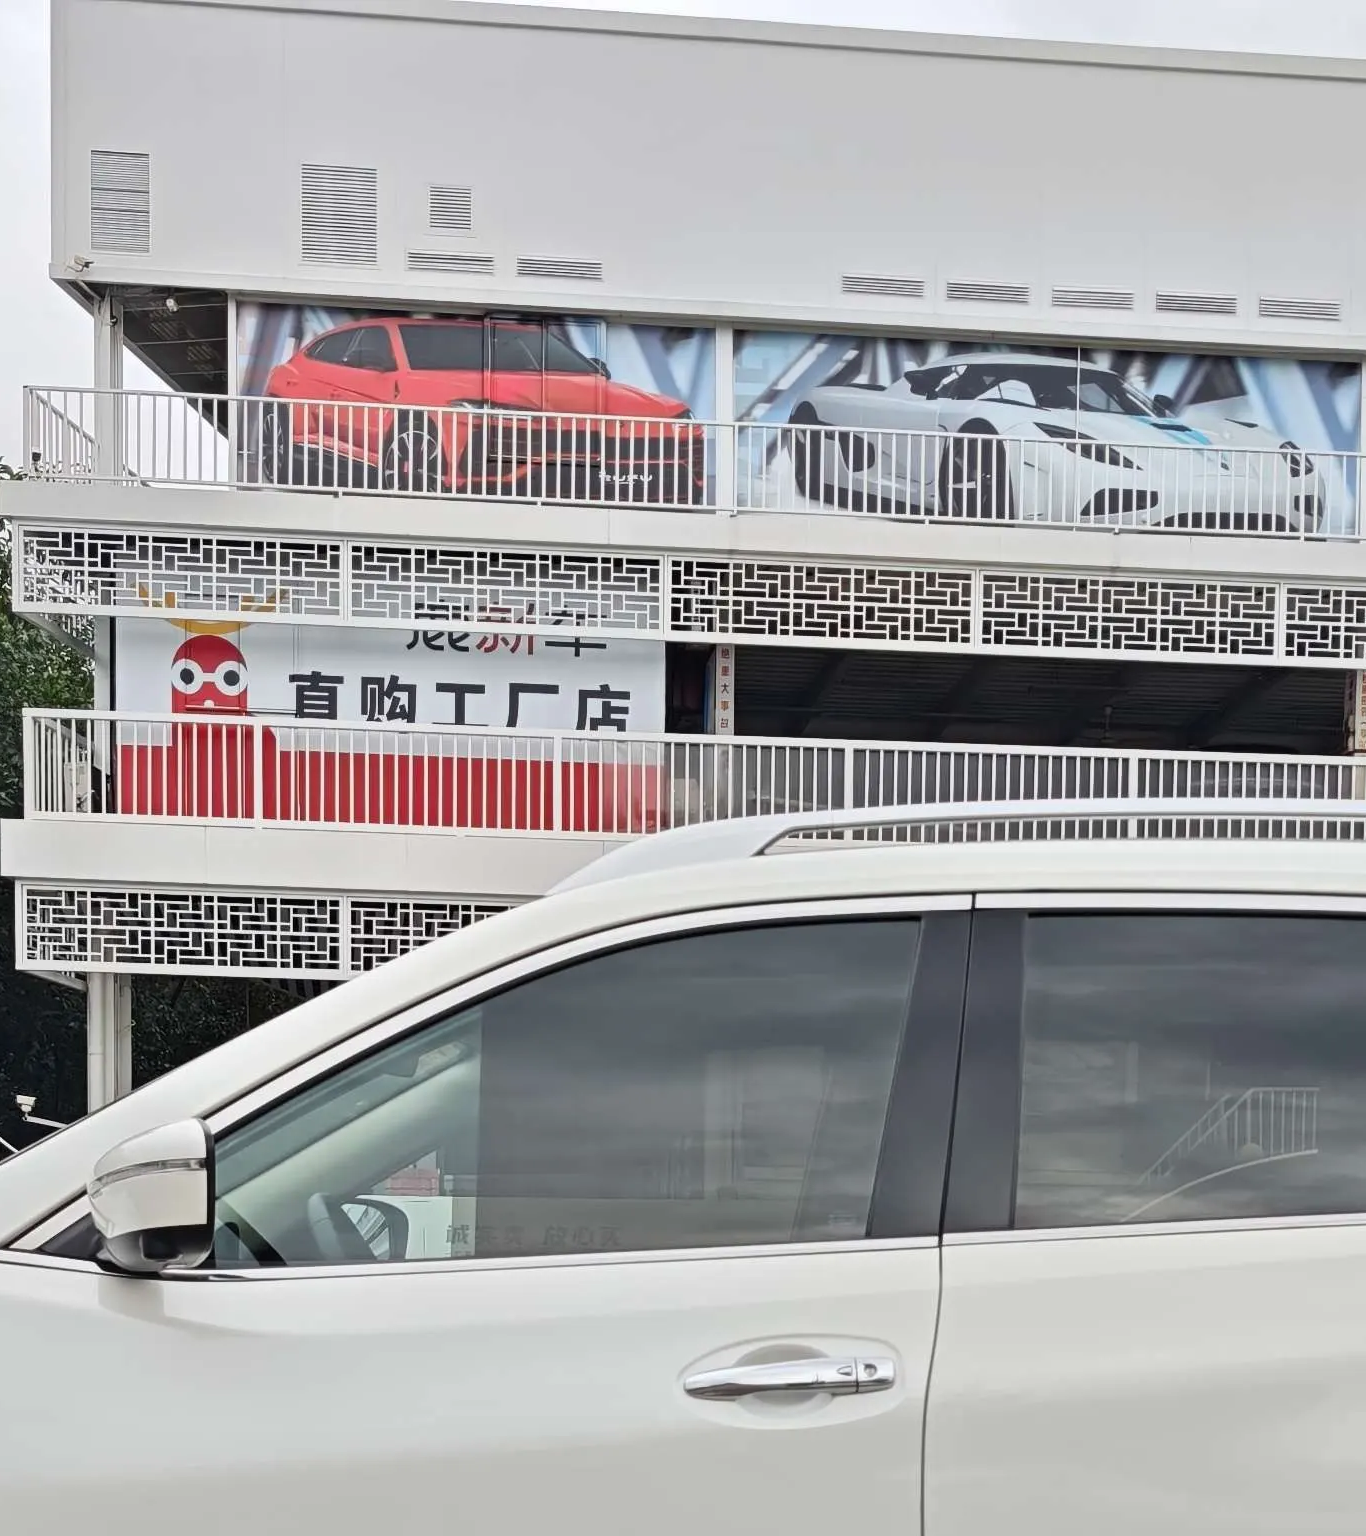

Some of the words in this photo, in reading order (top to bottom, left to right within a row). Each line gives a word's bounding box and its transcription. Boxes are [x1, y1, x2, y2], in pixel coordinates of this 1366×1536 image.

[289, 670, 632, 733] 直购工厂店
